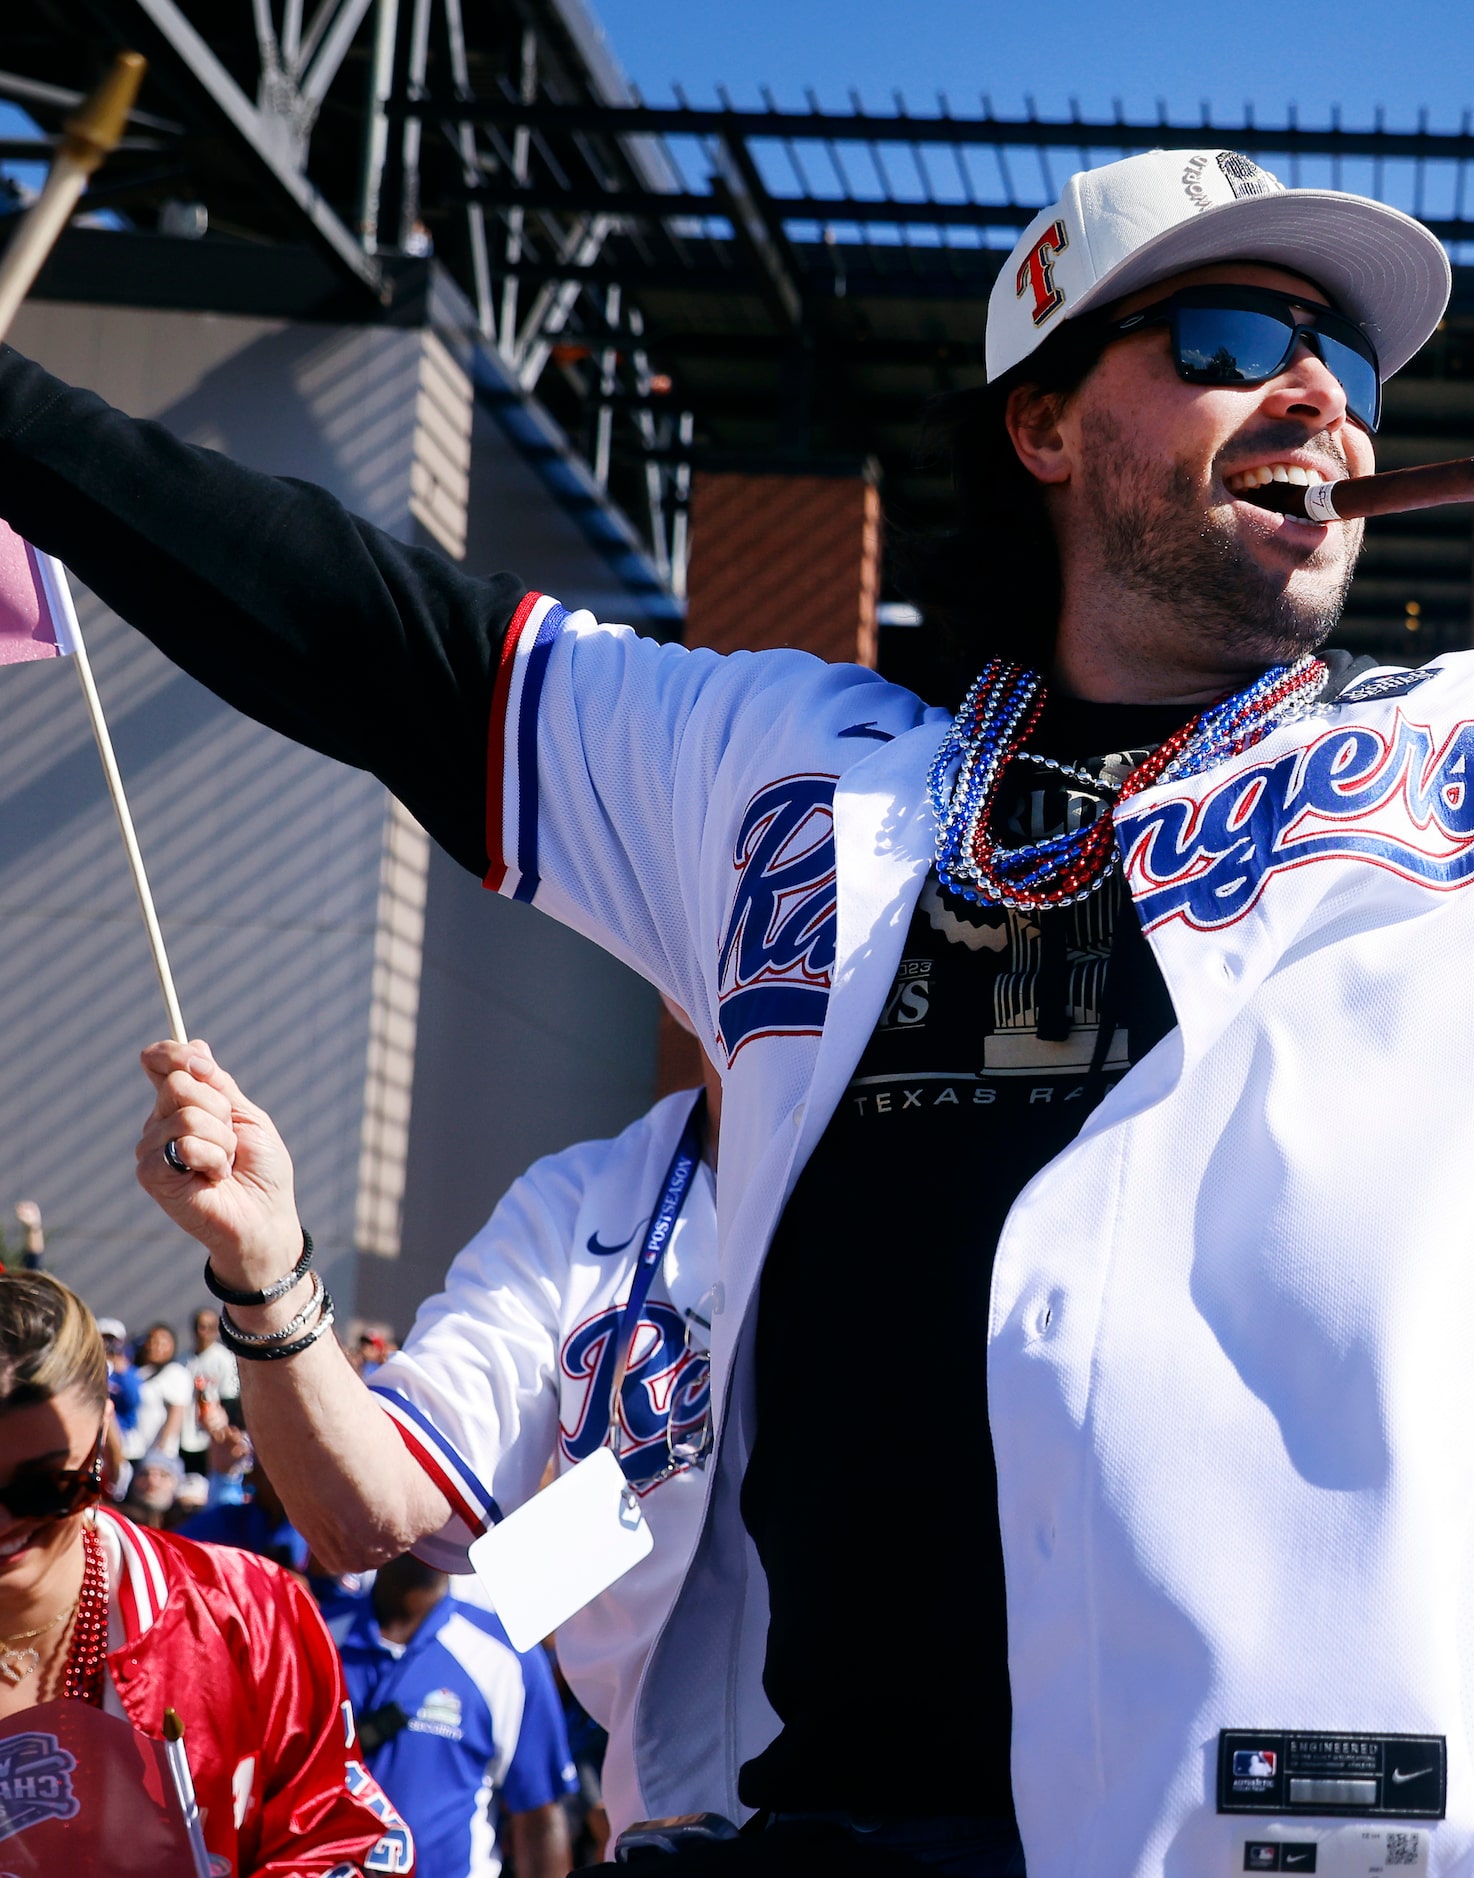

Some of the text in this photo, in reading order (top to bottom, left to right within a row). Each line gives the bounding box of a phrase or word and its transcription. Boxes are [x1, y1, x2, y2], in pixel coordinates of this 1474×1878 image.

[1015, 219, 1069, 329] T
[854, 1086, 997, 1117] TEXAS
[649, 1157, 693, 1251] POSTSEASON
[1290, 1740, 1379, 1755] ENGINEERED
